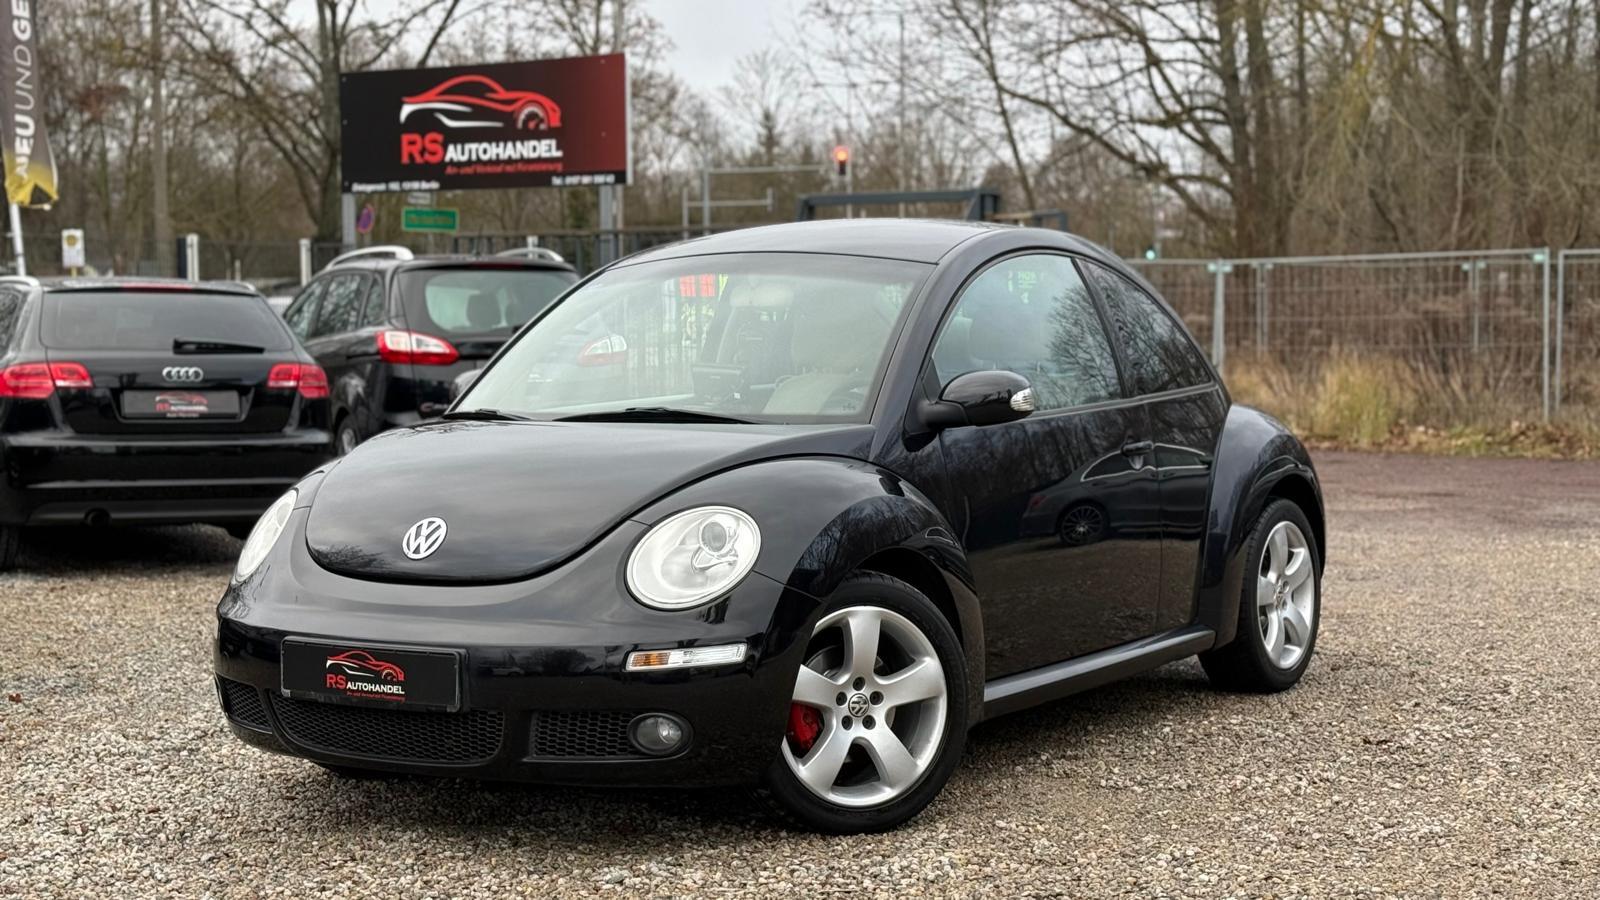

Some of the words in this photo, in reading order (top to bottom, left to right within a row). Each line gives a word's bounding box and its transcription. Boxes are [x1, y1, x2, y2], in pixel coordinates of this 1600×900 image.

[13, 44, 34, 111] UND
[401, 131, 444, 165] RS
[444, 139, 563, 163] AUTOHANDEL
[326, 673, 346, 690] RS
[346, 681, 405, 695] AUTOHANDEL
